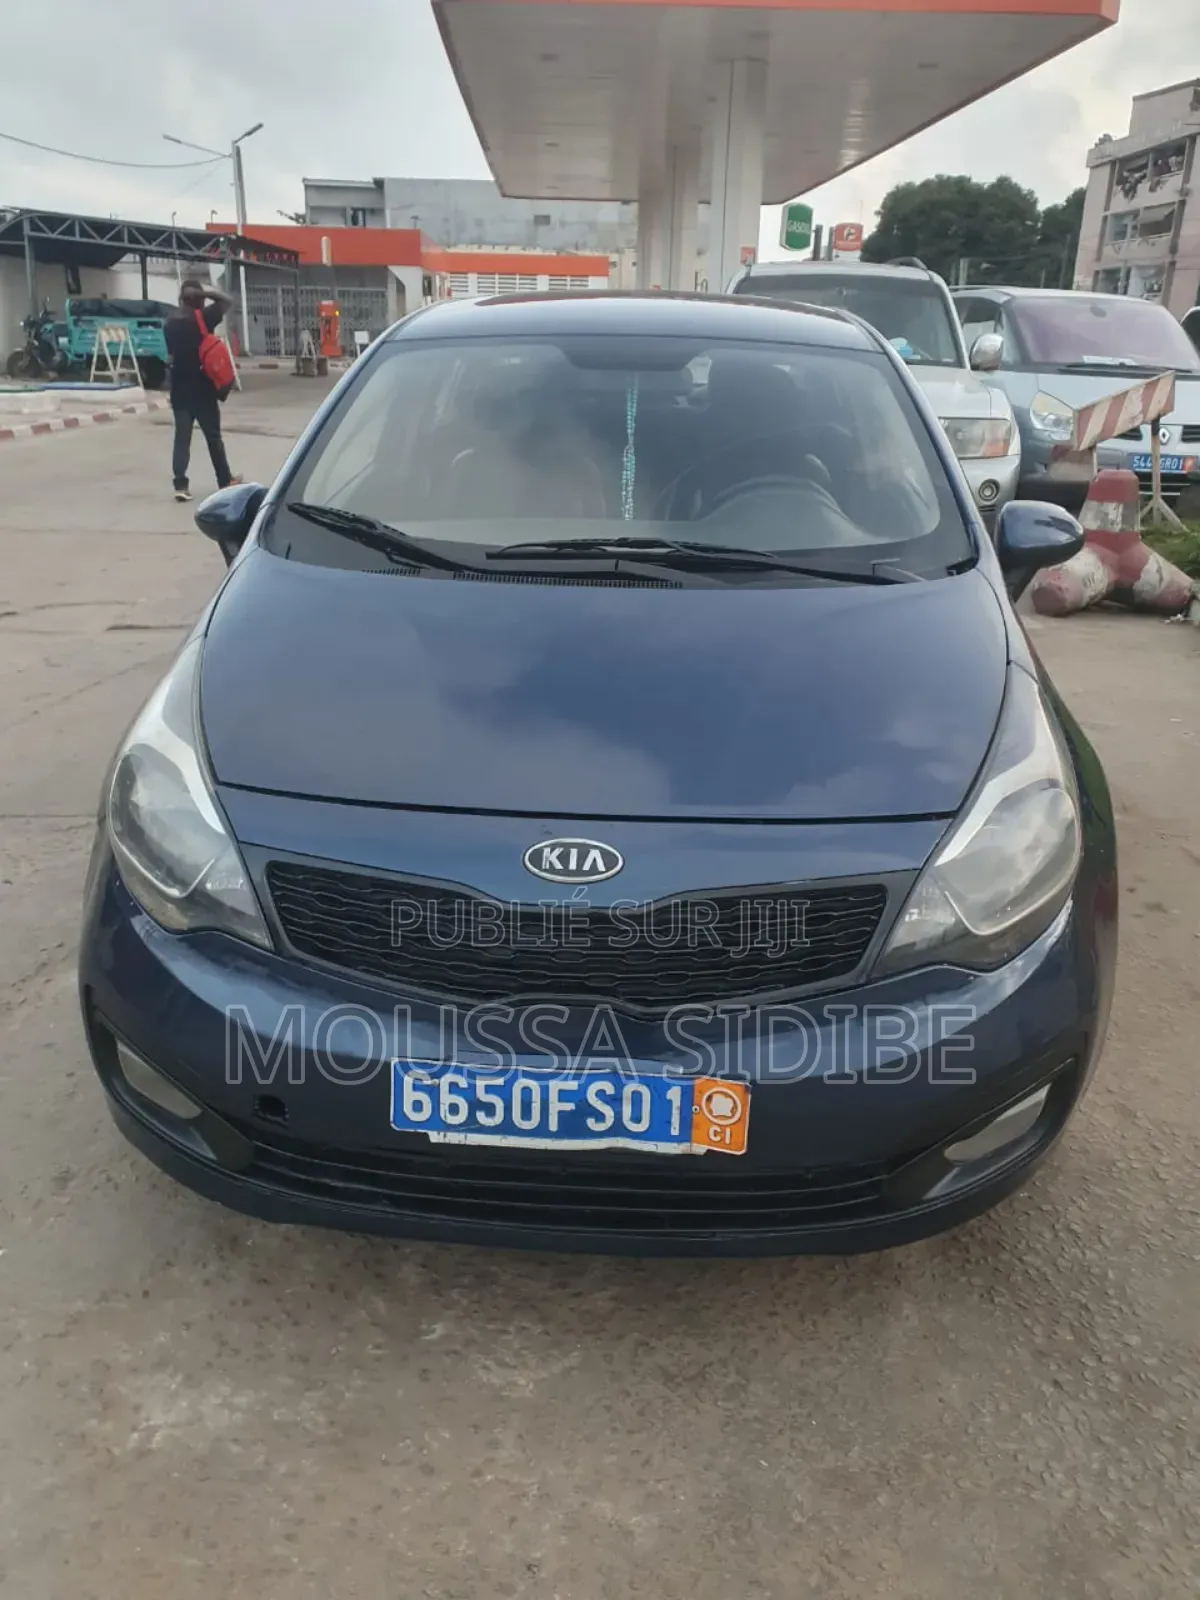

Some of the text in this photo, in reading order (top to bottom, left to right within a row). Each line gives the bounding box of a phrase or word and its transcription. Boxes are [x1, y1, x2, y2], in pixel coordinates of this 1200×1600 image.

[1133, 455, 1183, 470] 544GR01
[541, 847, 606, 871] KIA
[401, 1069, 682, 1137] 6650FS01
[708, 1125, 732, 1144] CI
